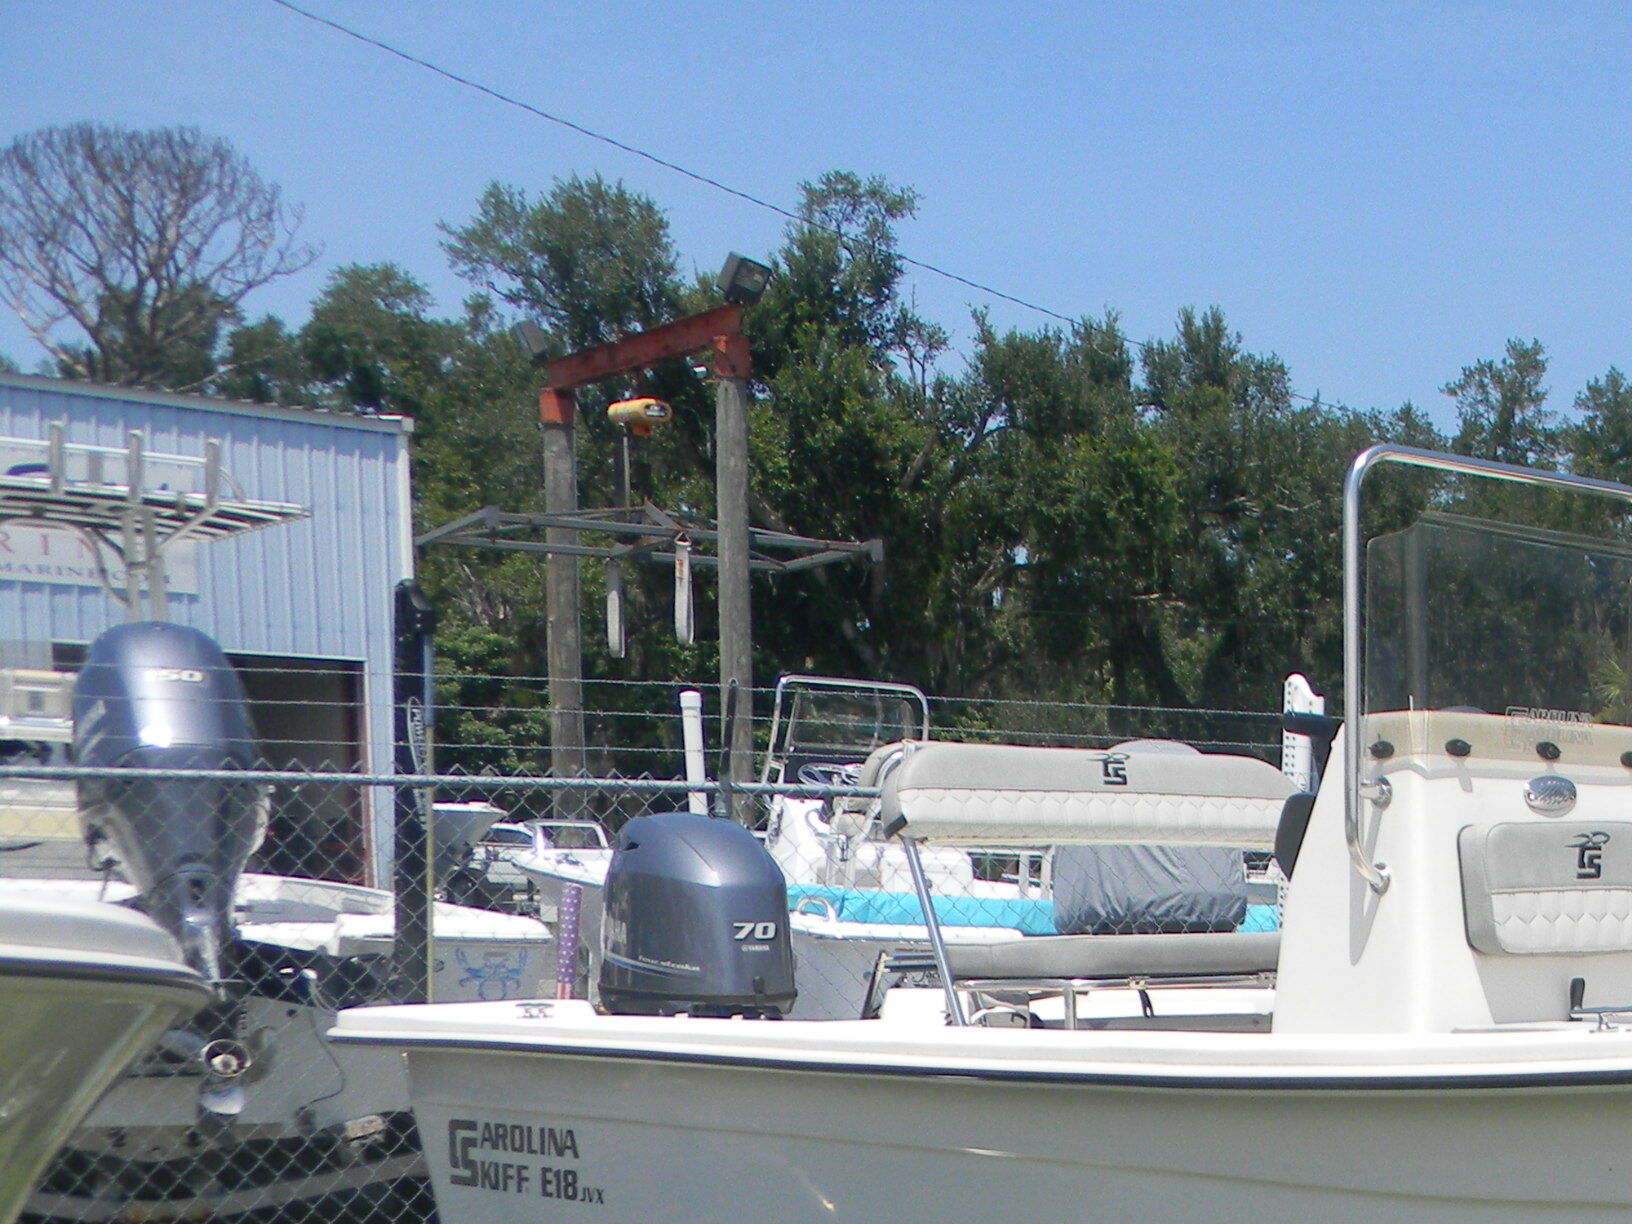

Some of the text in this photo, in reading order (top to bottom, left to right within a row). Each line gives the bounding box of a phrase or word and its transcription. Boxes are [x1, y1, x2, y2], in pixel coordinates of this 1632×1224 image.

[733, 922, 776, 940] 70
[449, 1119, 579, 1168] CAROLINA
[450, 1136, 529, 1194] SKIFF
